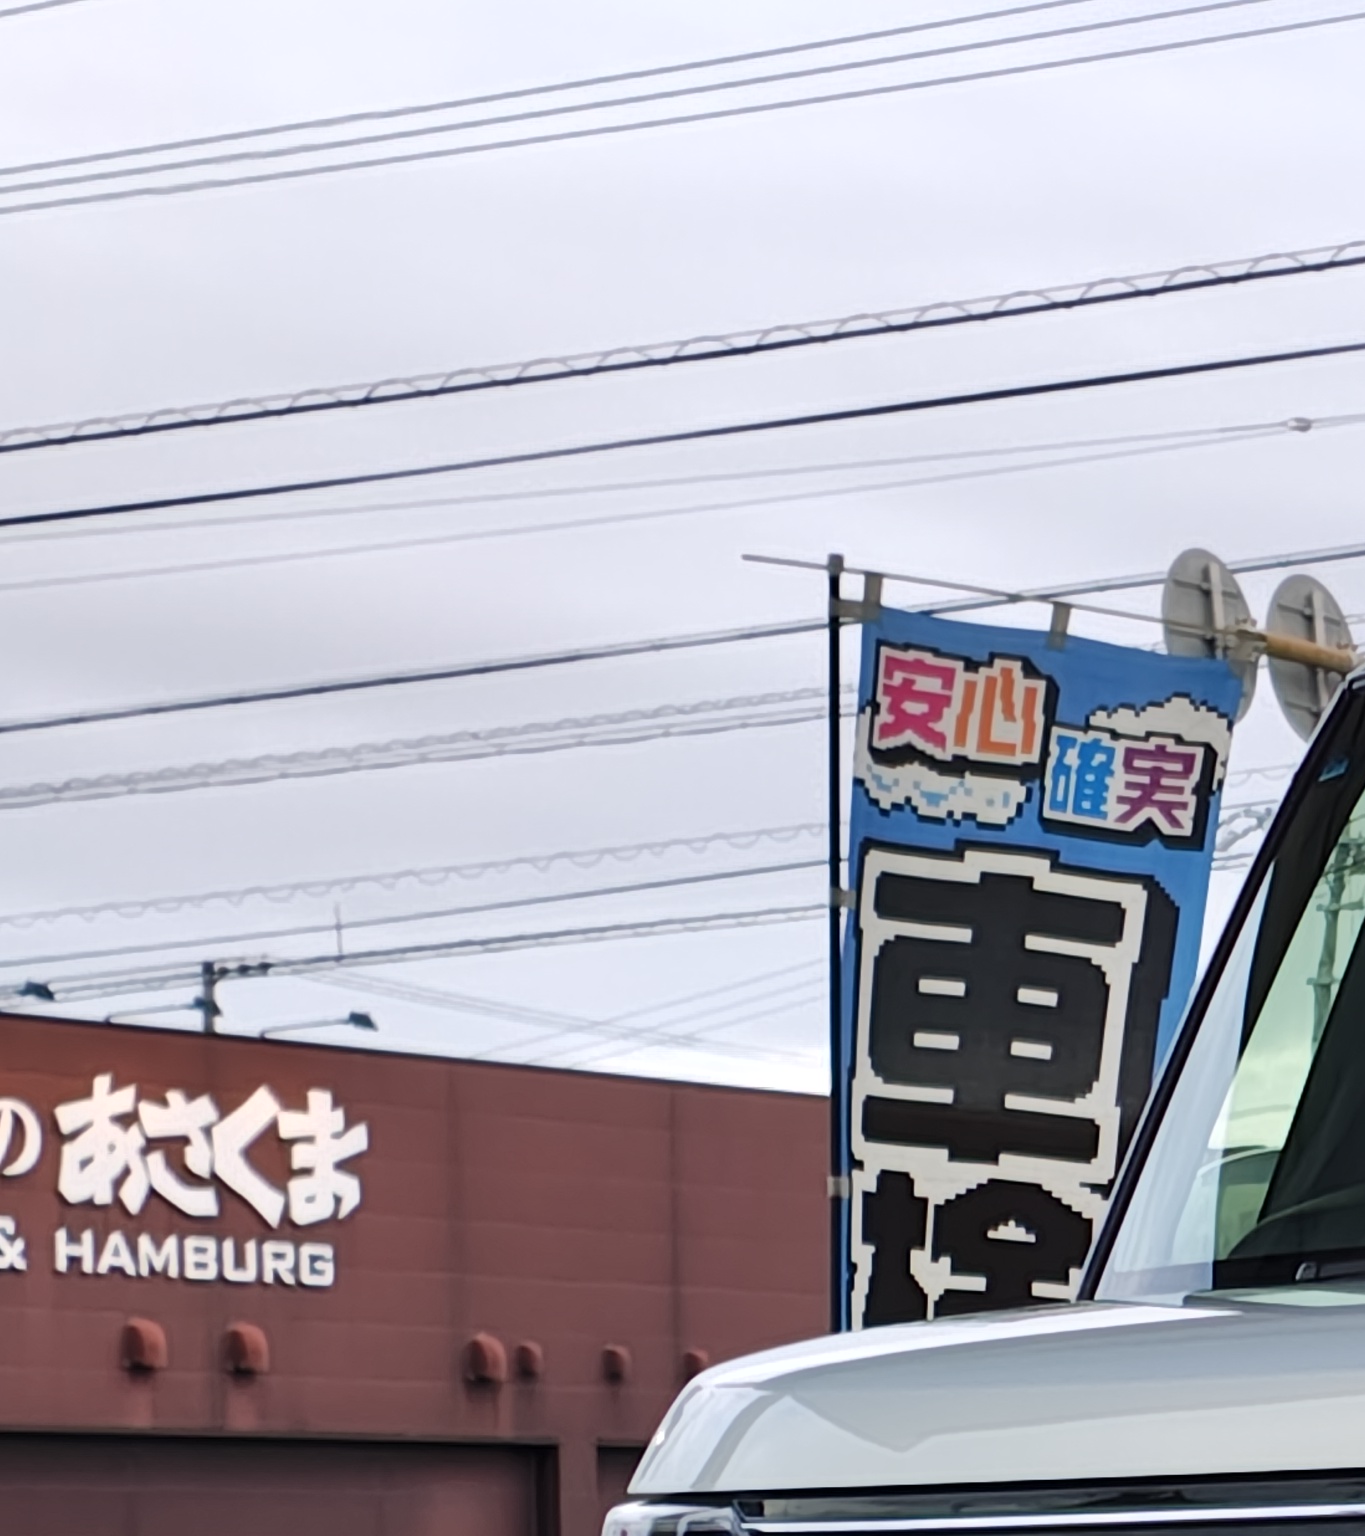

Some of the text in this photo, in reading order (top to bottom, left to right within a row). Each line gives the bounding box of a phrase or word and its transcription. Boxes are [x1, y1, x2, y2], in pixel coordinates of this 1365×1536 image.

[880, 650, 1040, 757] 安心
[1049, 731, 1198, 832] 確実
[54, 1227, 335, 1287] HAMBURG
